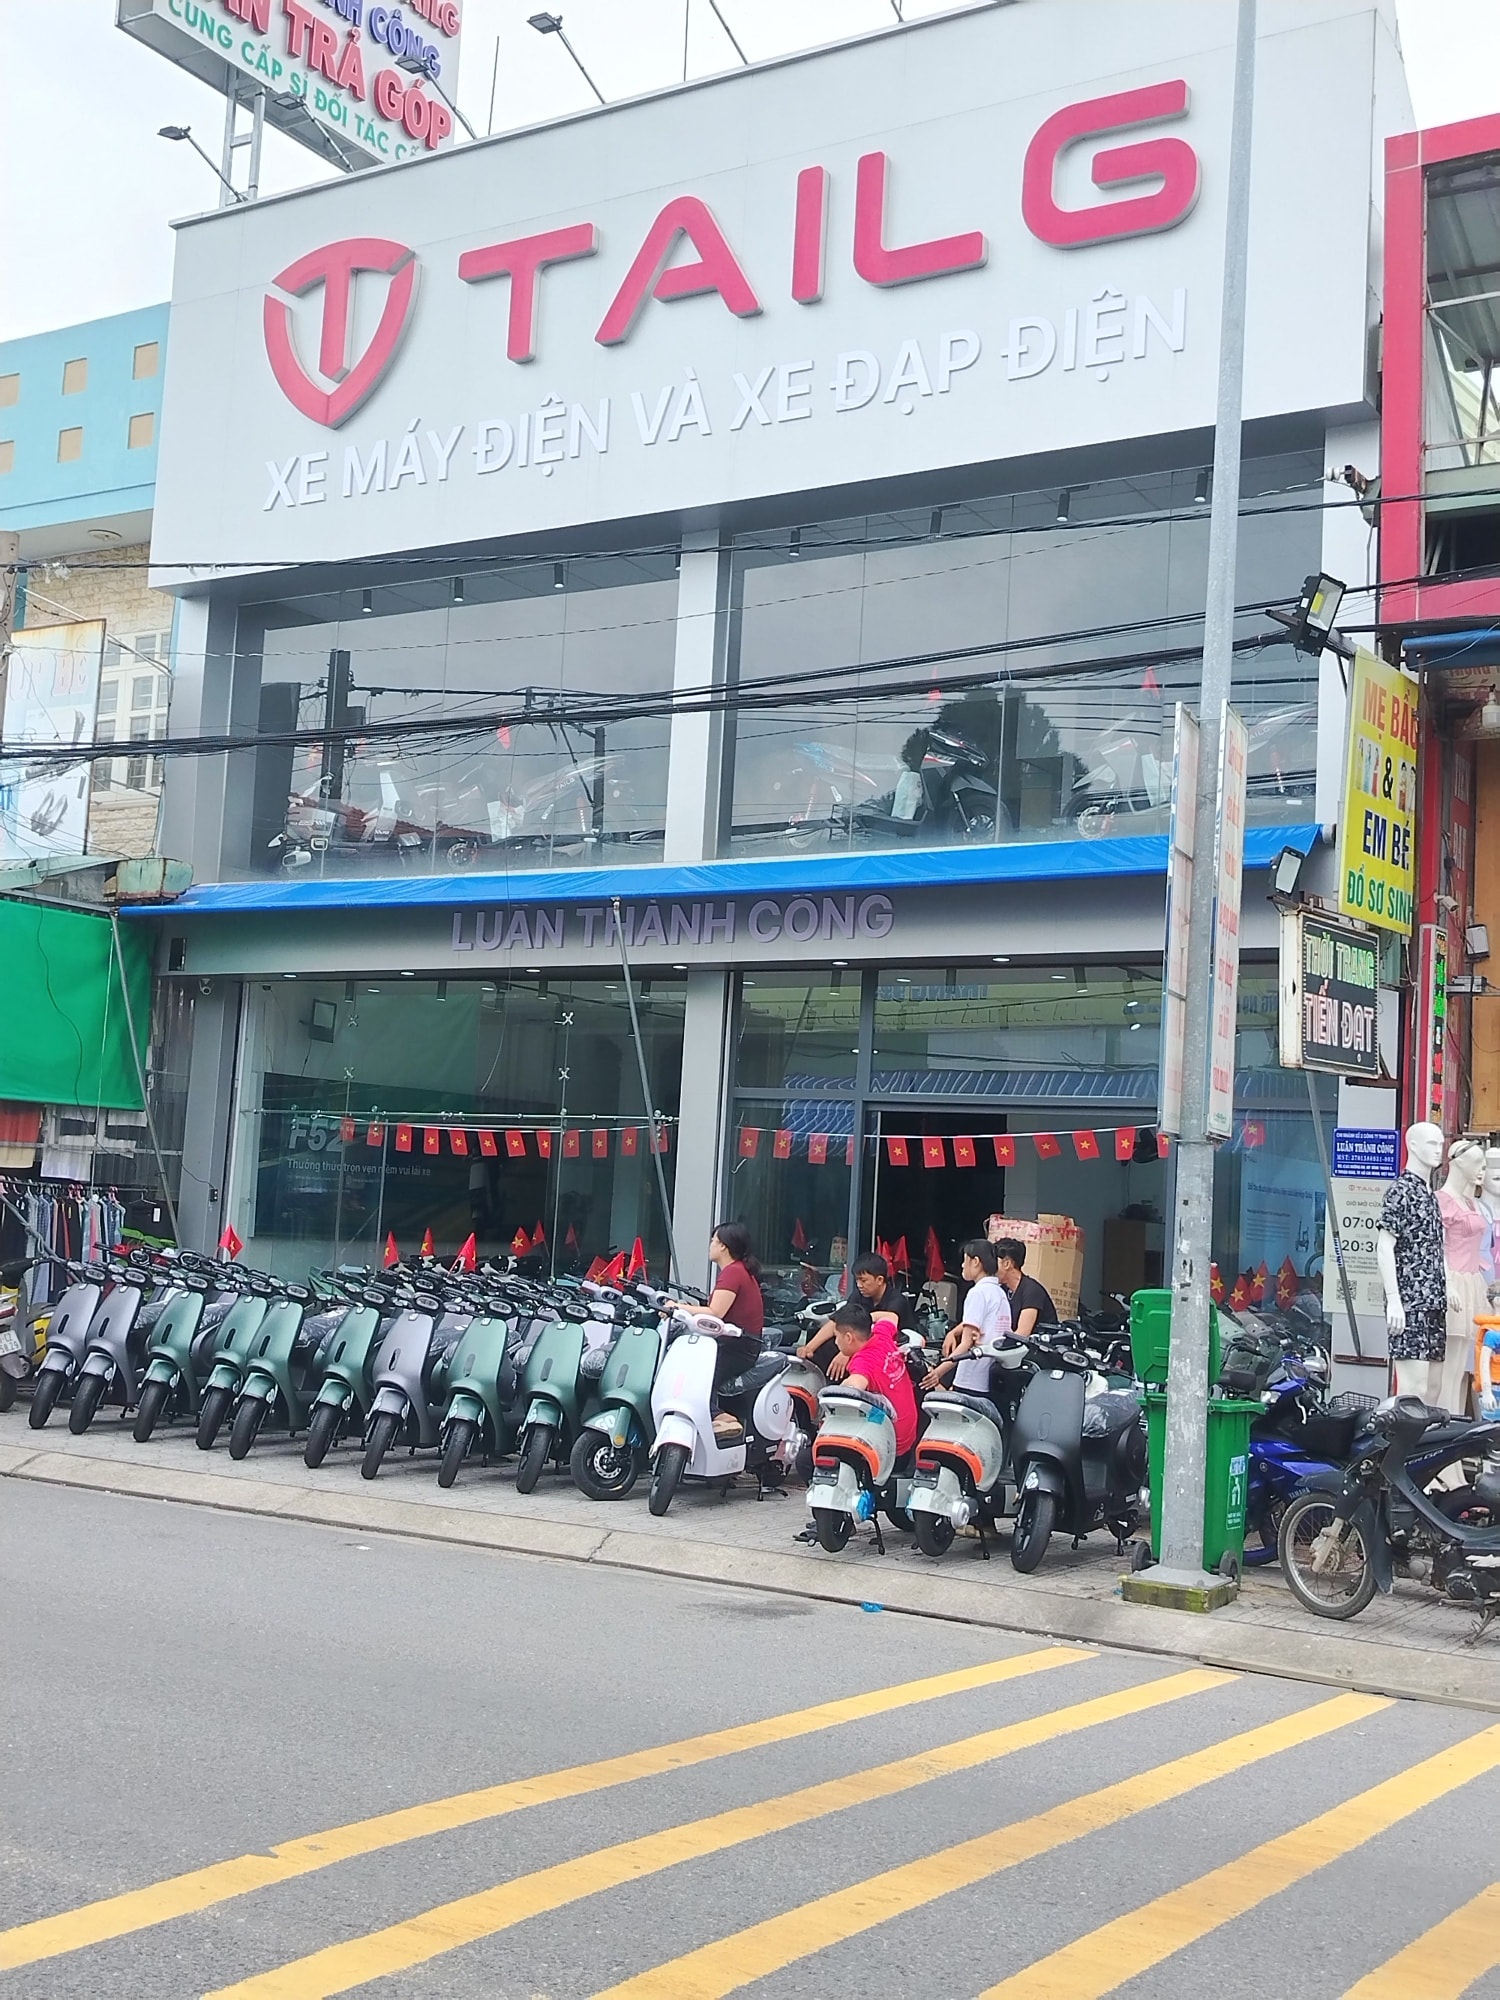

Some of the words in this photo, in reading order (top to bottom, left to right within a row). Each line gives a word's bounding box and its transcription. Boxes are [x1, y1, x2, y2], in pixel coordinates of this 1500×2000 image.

[283, 0, 365, 102] TRẢ
[374, 69, 451, 150] GÓP
[369, 8, 441, 80] CÔNG
[168, 0, 233, 49] CUNG
[354, 113, 389, 153] TÁC
[458, 78, 1203, 364] TAILG
[263, 451, 328, 512] XE
[341, 417, 466, 498] MÁY
[472, 392, 612, 477] ĐIỆN
[631, 367, 712, 445] VÀ
[729, 359, 815, 431] XE
[829, 328, 981, 416] ĐẠP
[1000, 282, 1188, 382] ĐIỆN
[1363, 676, 1387, 741] MẸ
[1382, 755, 1393, 801] &
[1362, 808, 1387, 861] EM
[1391, 821, 1410, 871] BÉ
[747, 893, 895, 944] CÔNG
[1347, 864, 1365, 909] ĐỒ
[1367, 875, 1386, 916] SƠ
[1387, 885, 1414, 926] SINH
[1304, 932, 1334, 980] THỜI
[1336, 941, 1375, 990] TRANG
[1304, 978, 1339, 1047] TIẾN
[1340, 1001, 1375, 1063] ĐẠT
[1341, 1239, 1378, 1253] 20:3
[1342, 1216, 1379, 1230] 07:0
